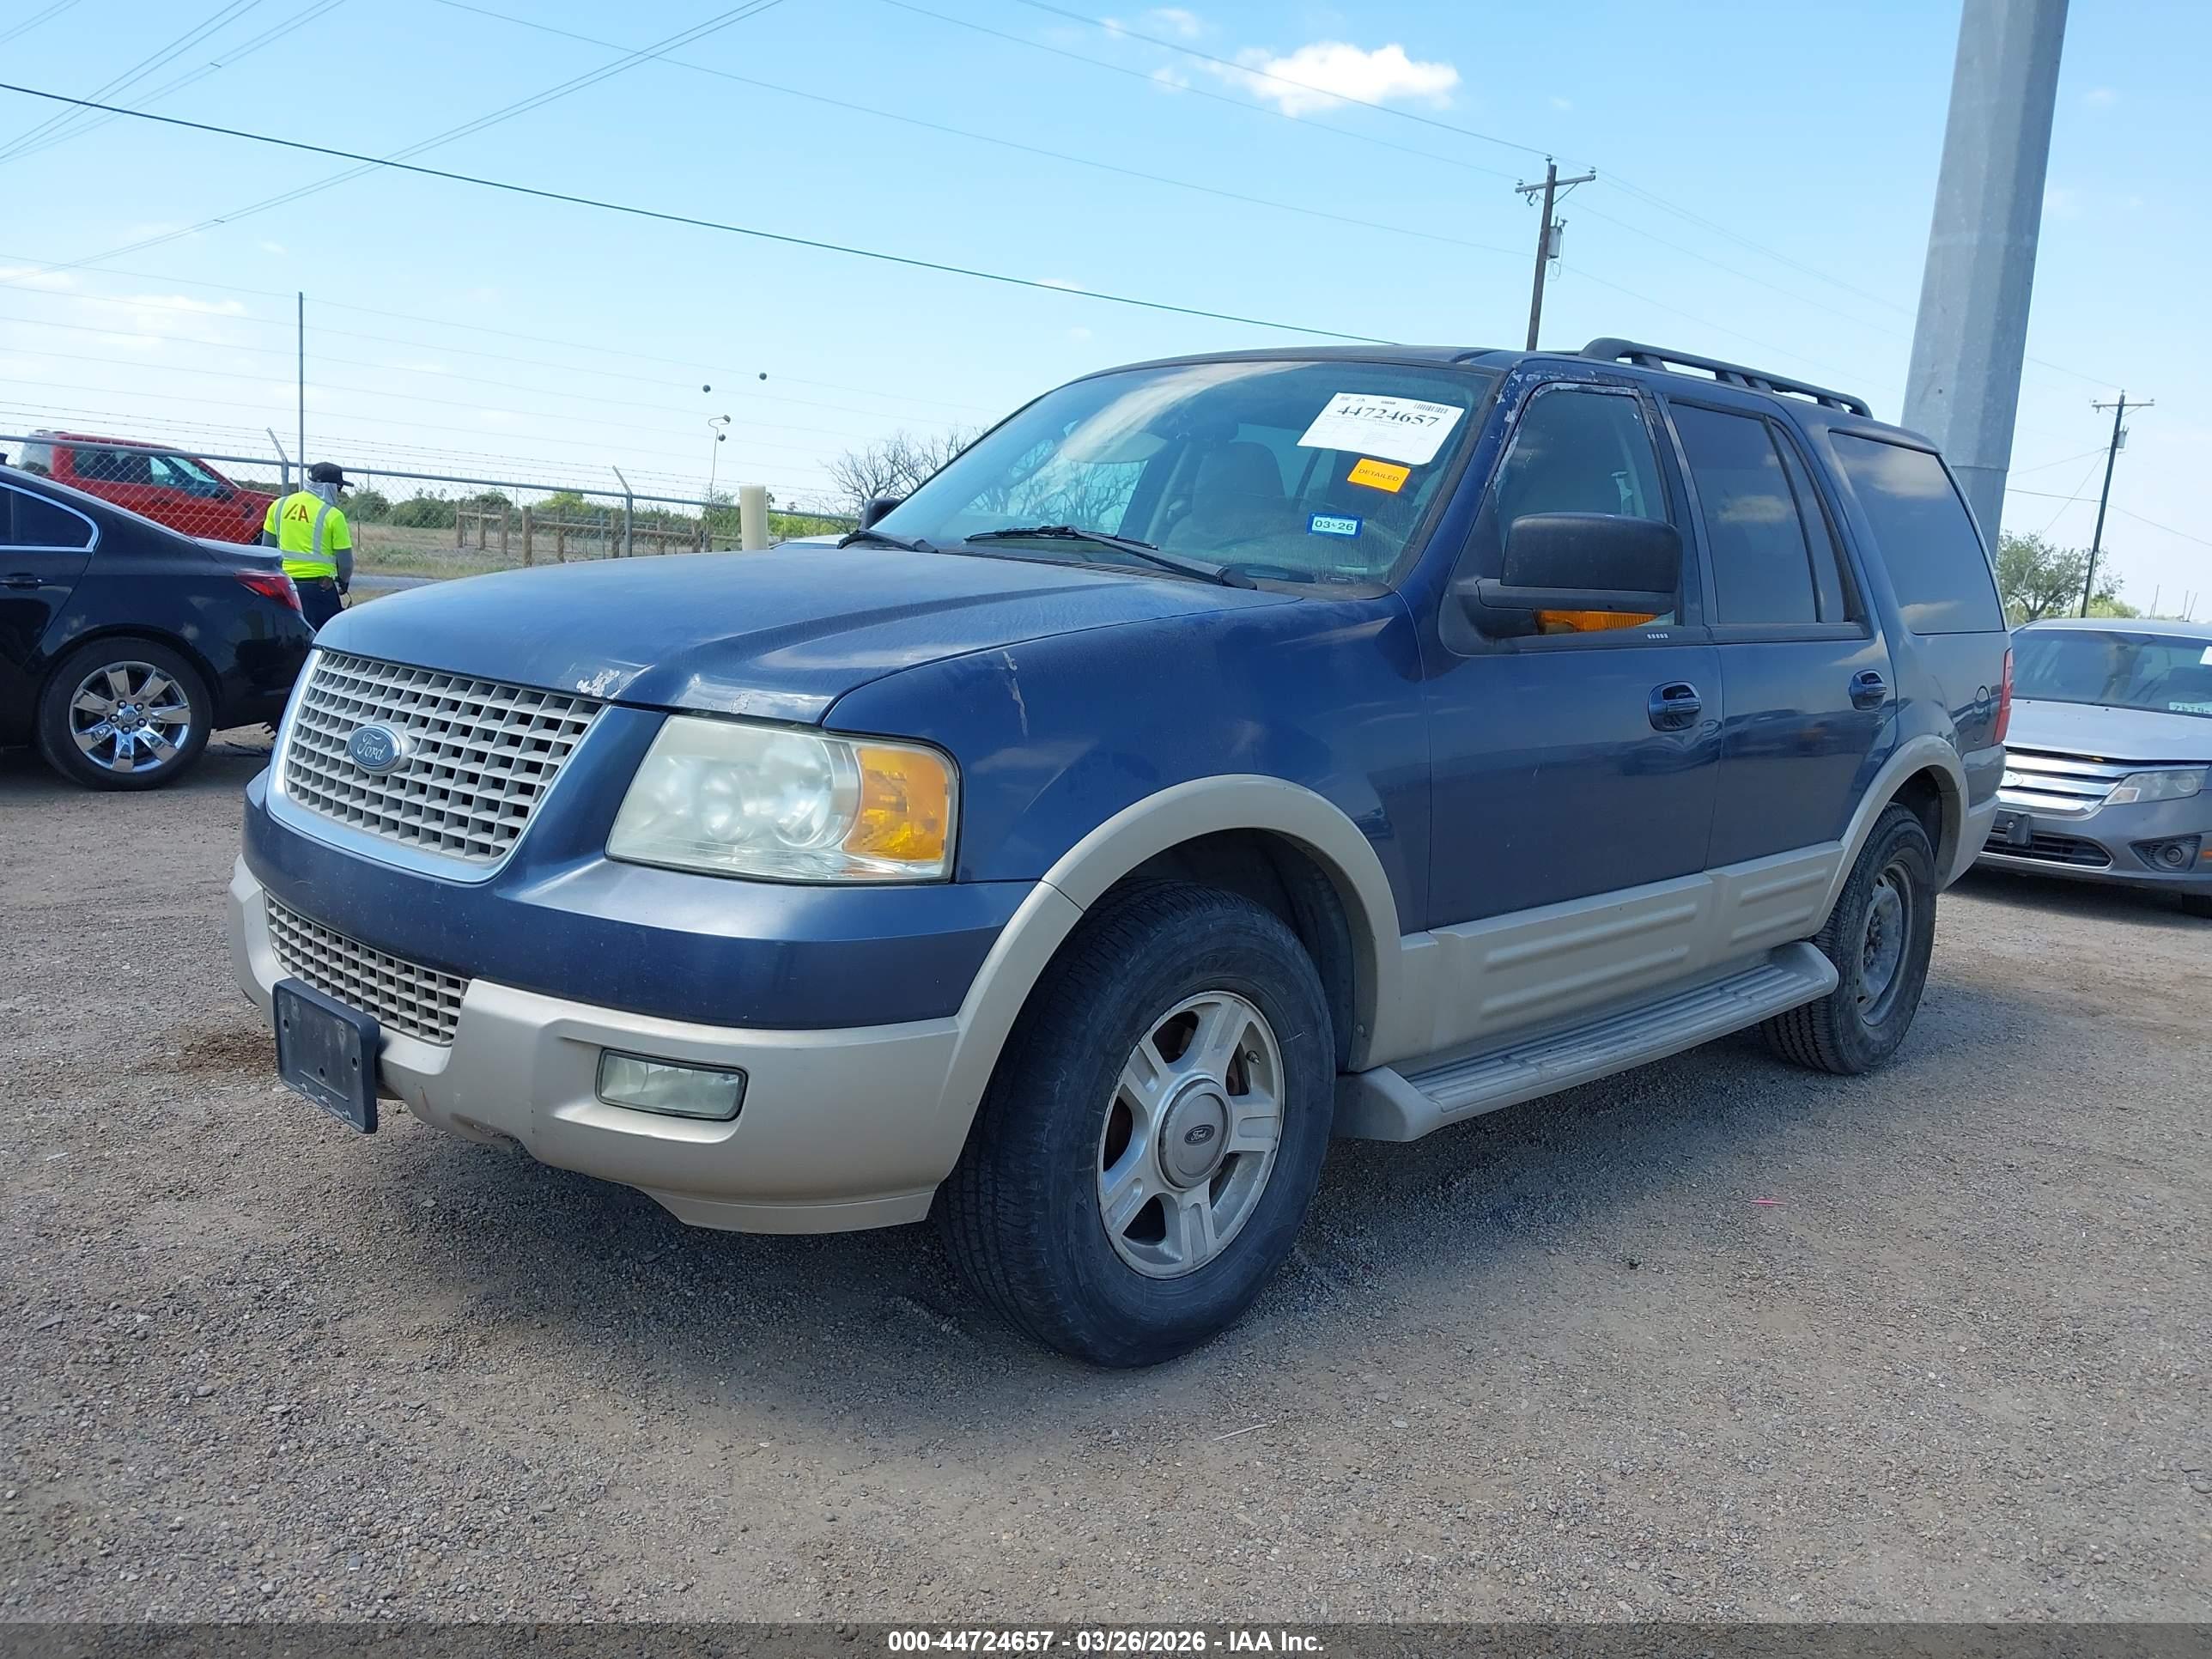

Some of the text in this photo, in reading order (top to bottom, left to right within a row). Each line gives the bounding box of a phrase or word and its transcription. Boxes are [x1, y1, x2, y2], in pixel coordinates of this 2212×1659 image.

[1337, 405, 1440, 427] 44724657
[1358, 468, 1400, 482] DETAILED
[356, 732, 387, 761] Ford
[1191, 1129, 1206, 1140] Ford
